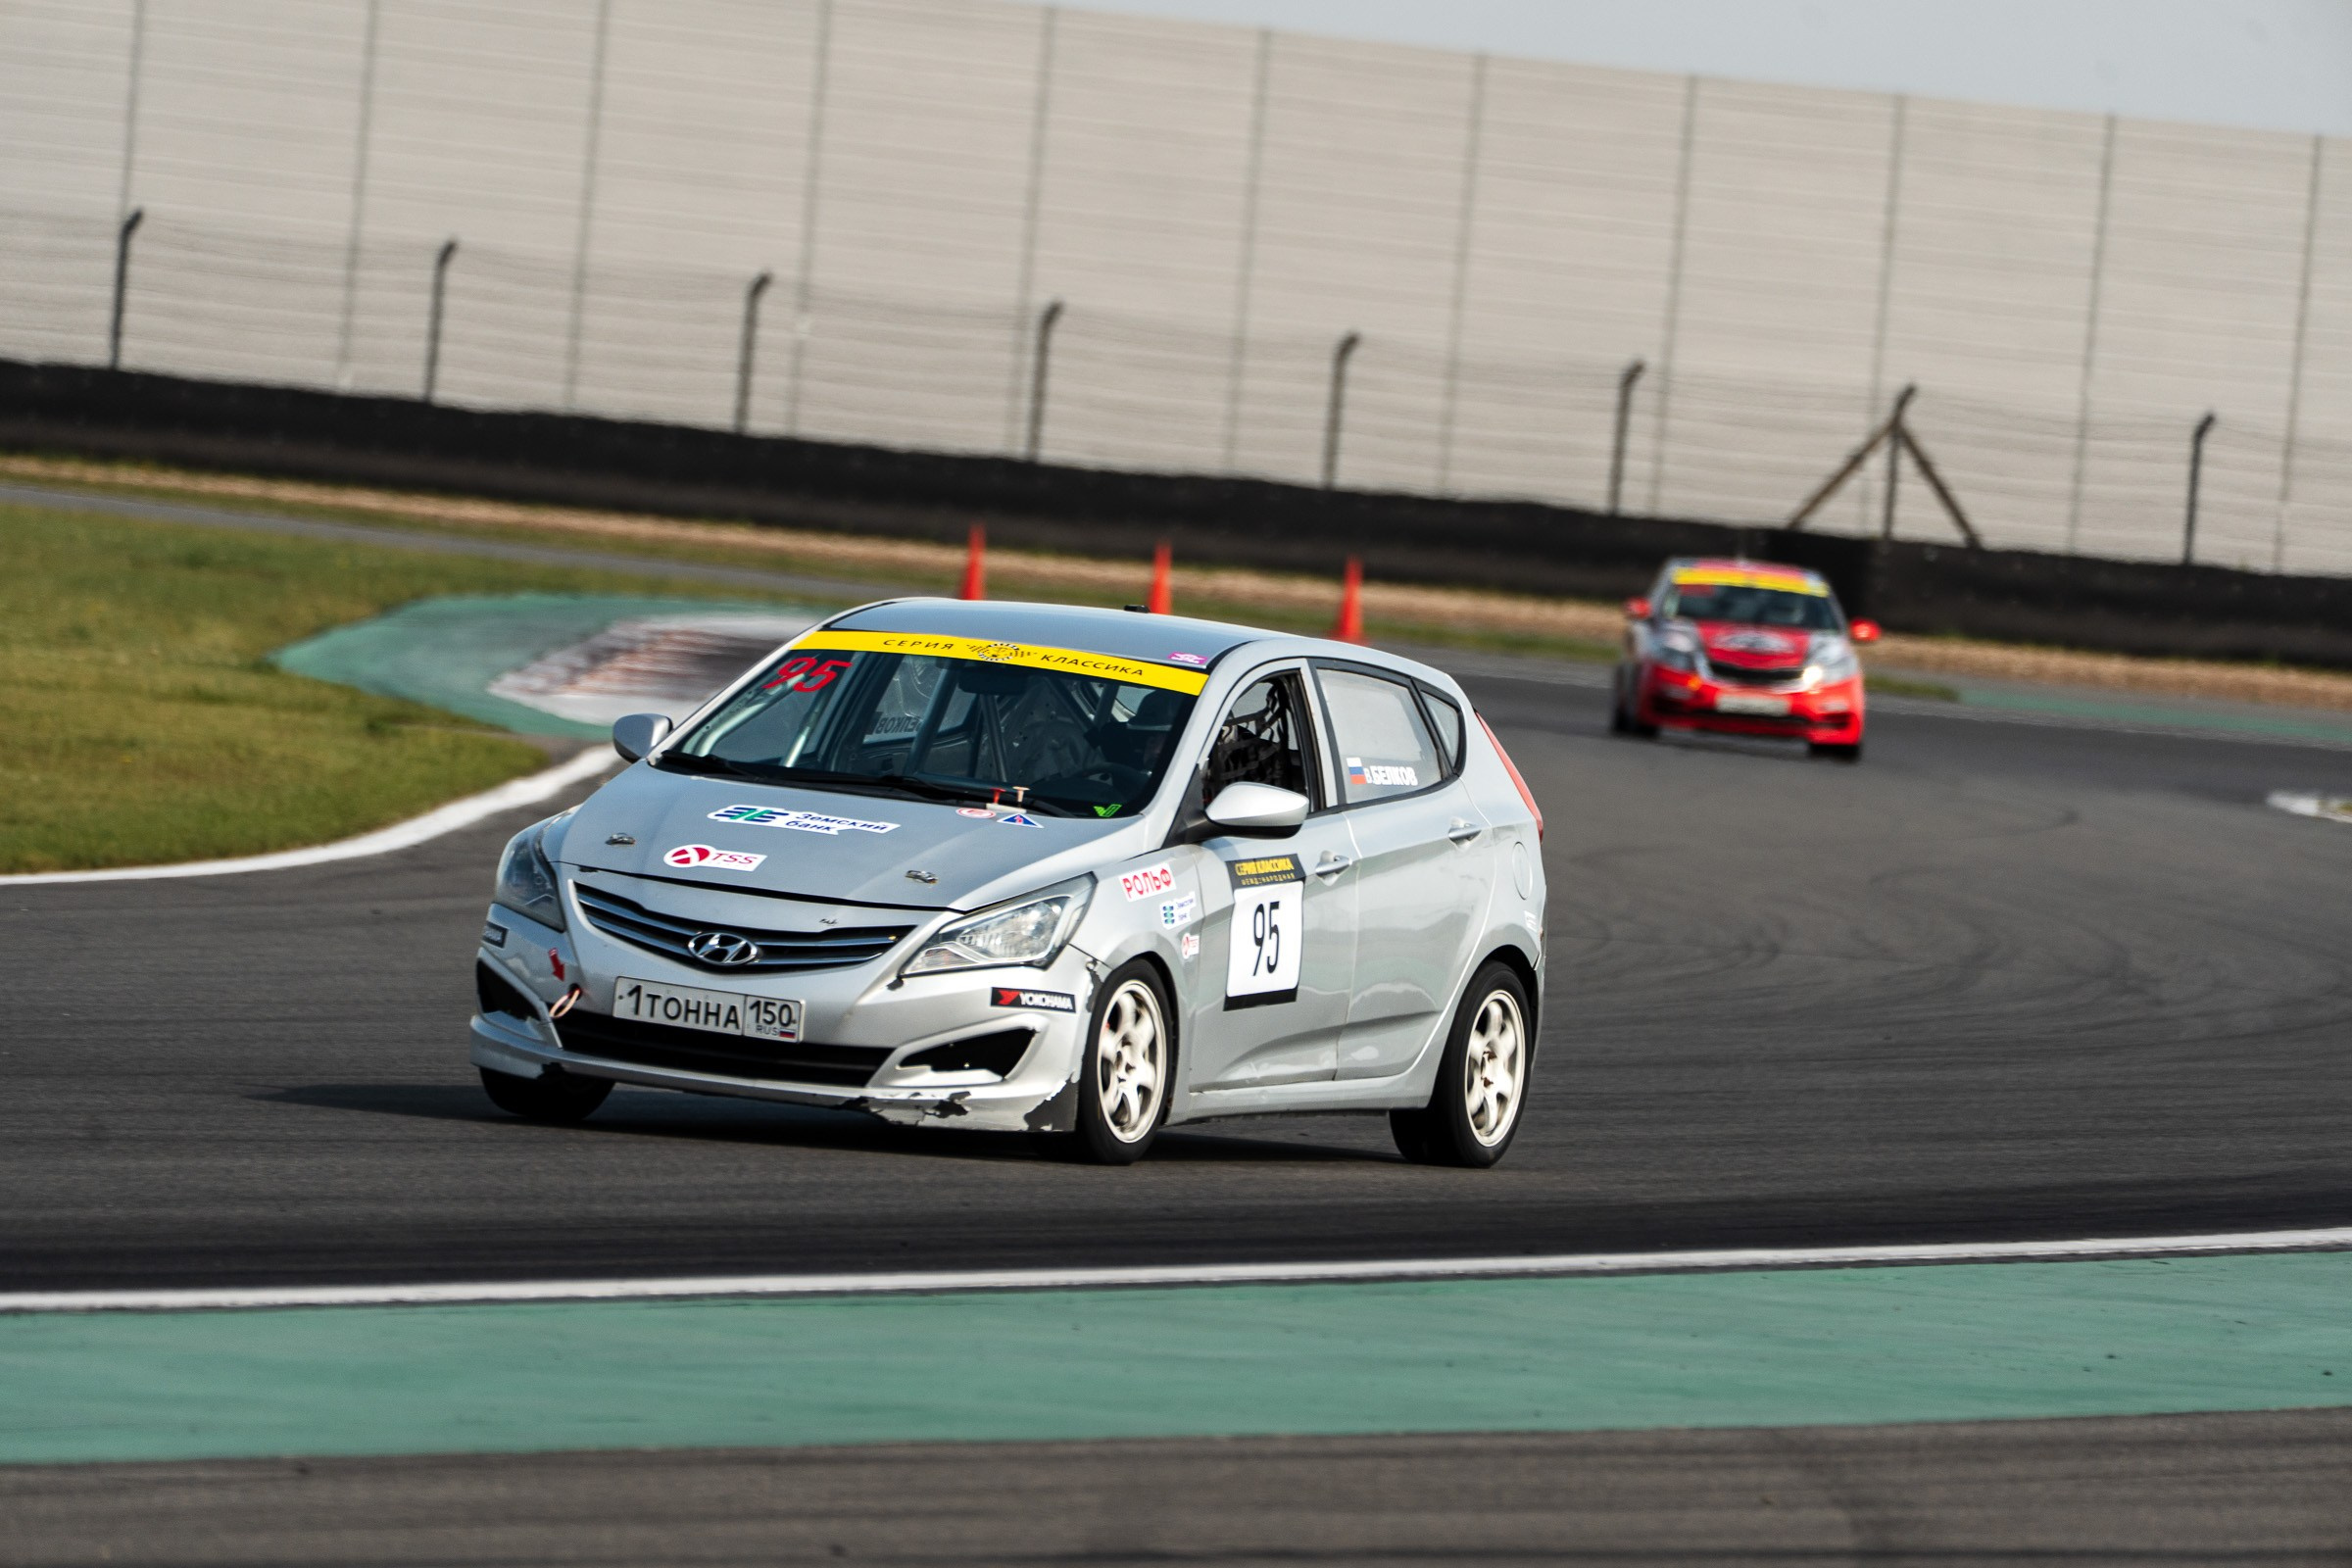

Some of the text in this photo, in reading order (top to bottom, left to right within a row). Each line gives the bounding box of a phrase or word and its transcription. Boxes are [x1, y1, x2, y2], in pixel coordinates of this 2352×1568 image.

[882, 639, 1144, 676] СЕРИЯ КЛАССИКА
[761, 657, 854, 693] 95
[784, 820, 837, 832] банк
[795, 812, 889, 831] Земский
[711, 853, 759, 864] TSS
[1121, 867, 1173, 900] РОЛЬФ
[1251, 900, 1281, 977] 95
[626, 984, 793, 1030] 1ТОННА 150
[1019, 992, 1074, 1010] YOKOHAMA
[755, 1024, 779, 1037] RUS
